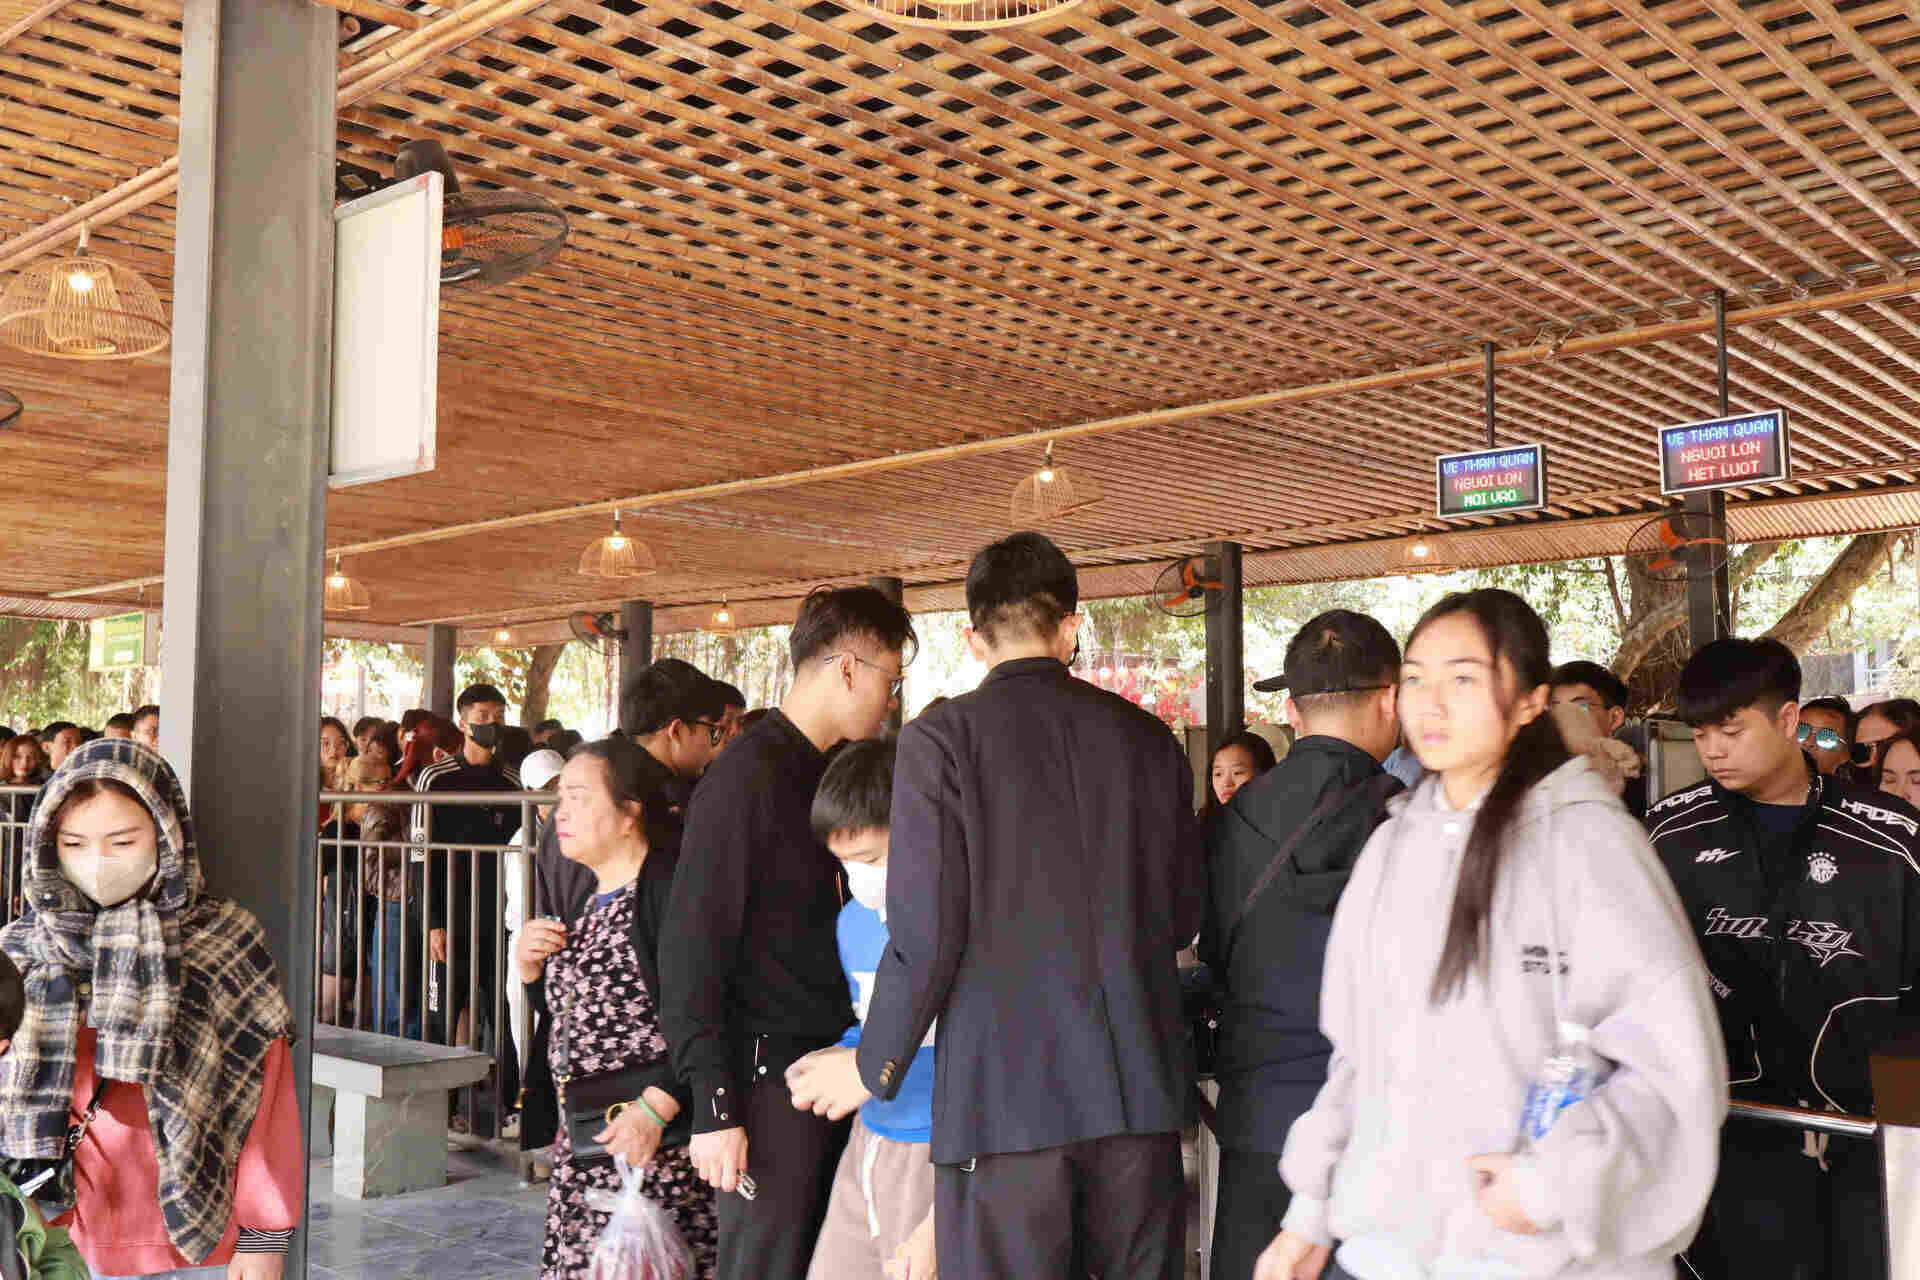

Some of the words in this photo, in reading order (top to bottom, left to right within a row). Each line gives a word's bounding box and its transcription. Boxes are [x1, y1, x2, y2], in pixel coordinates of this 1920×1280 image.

[1691, 425, 1729, 442] THAM
[1733, 418, 1775, 436] QUAN
[1463, 455, 1497, 473] THAM
[1500, 452, 1534, 467] QUAN
[1680, 445, 1728, 464] NGUOI
[1731, 440, 1760, 457] LON
[1496, 470, 1524, 486] LON
[1688, 465, 1718, 481] HET
[1720, 460, 1760, 478] LUOT
[1490, 489, 1517, 504] VAO
[1841, 798, 1919, 836] HADES
